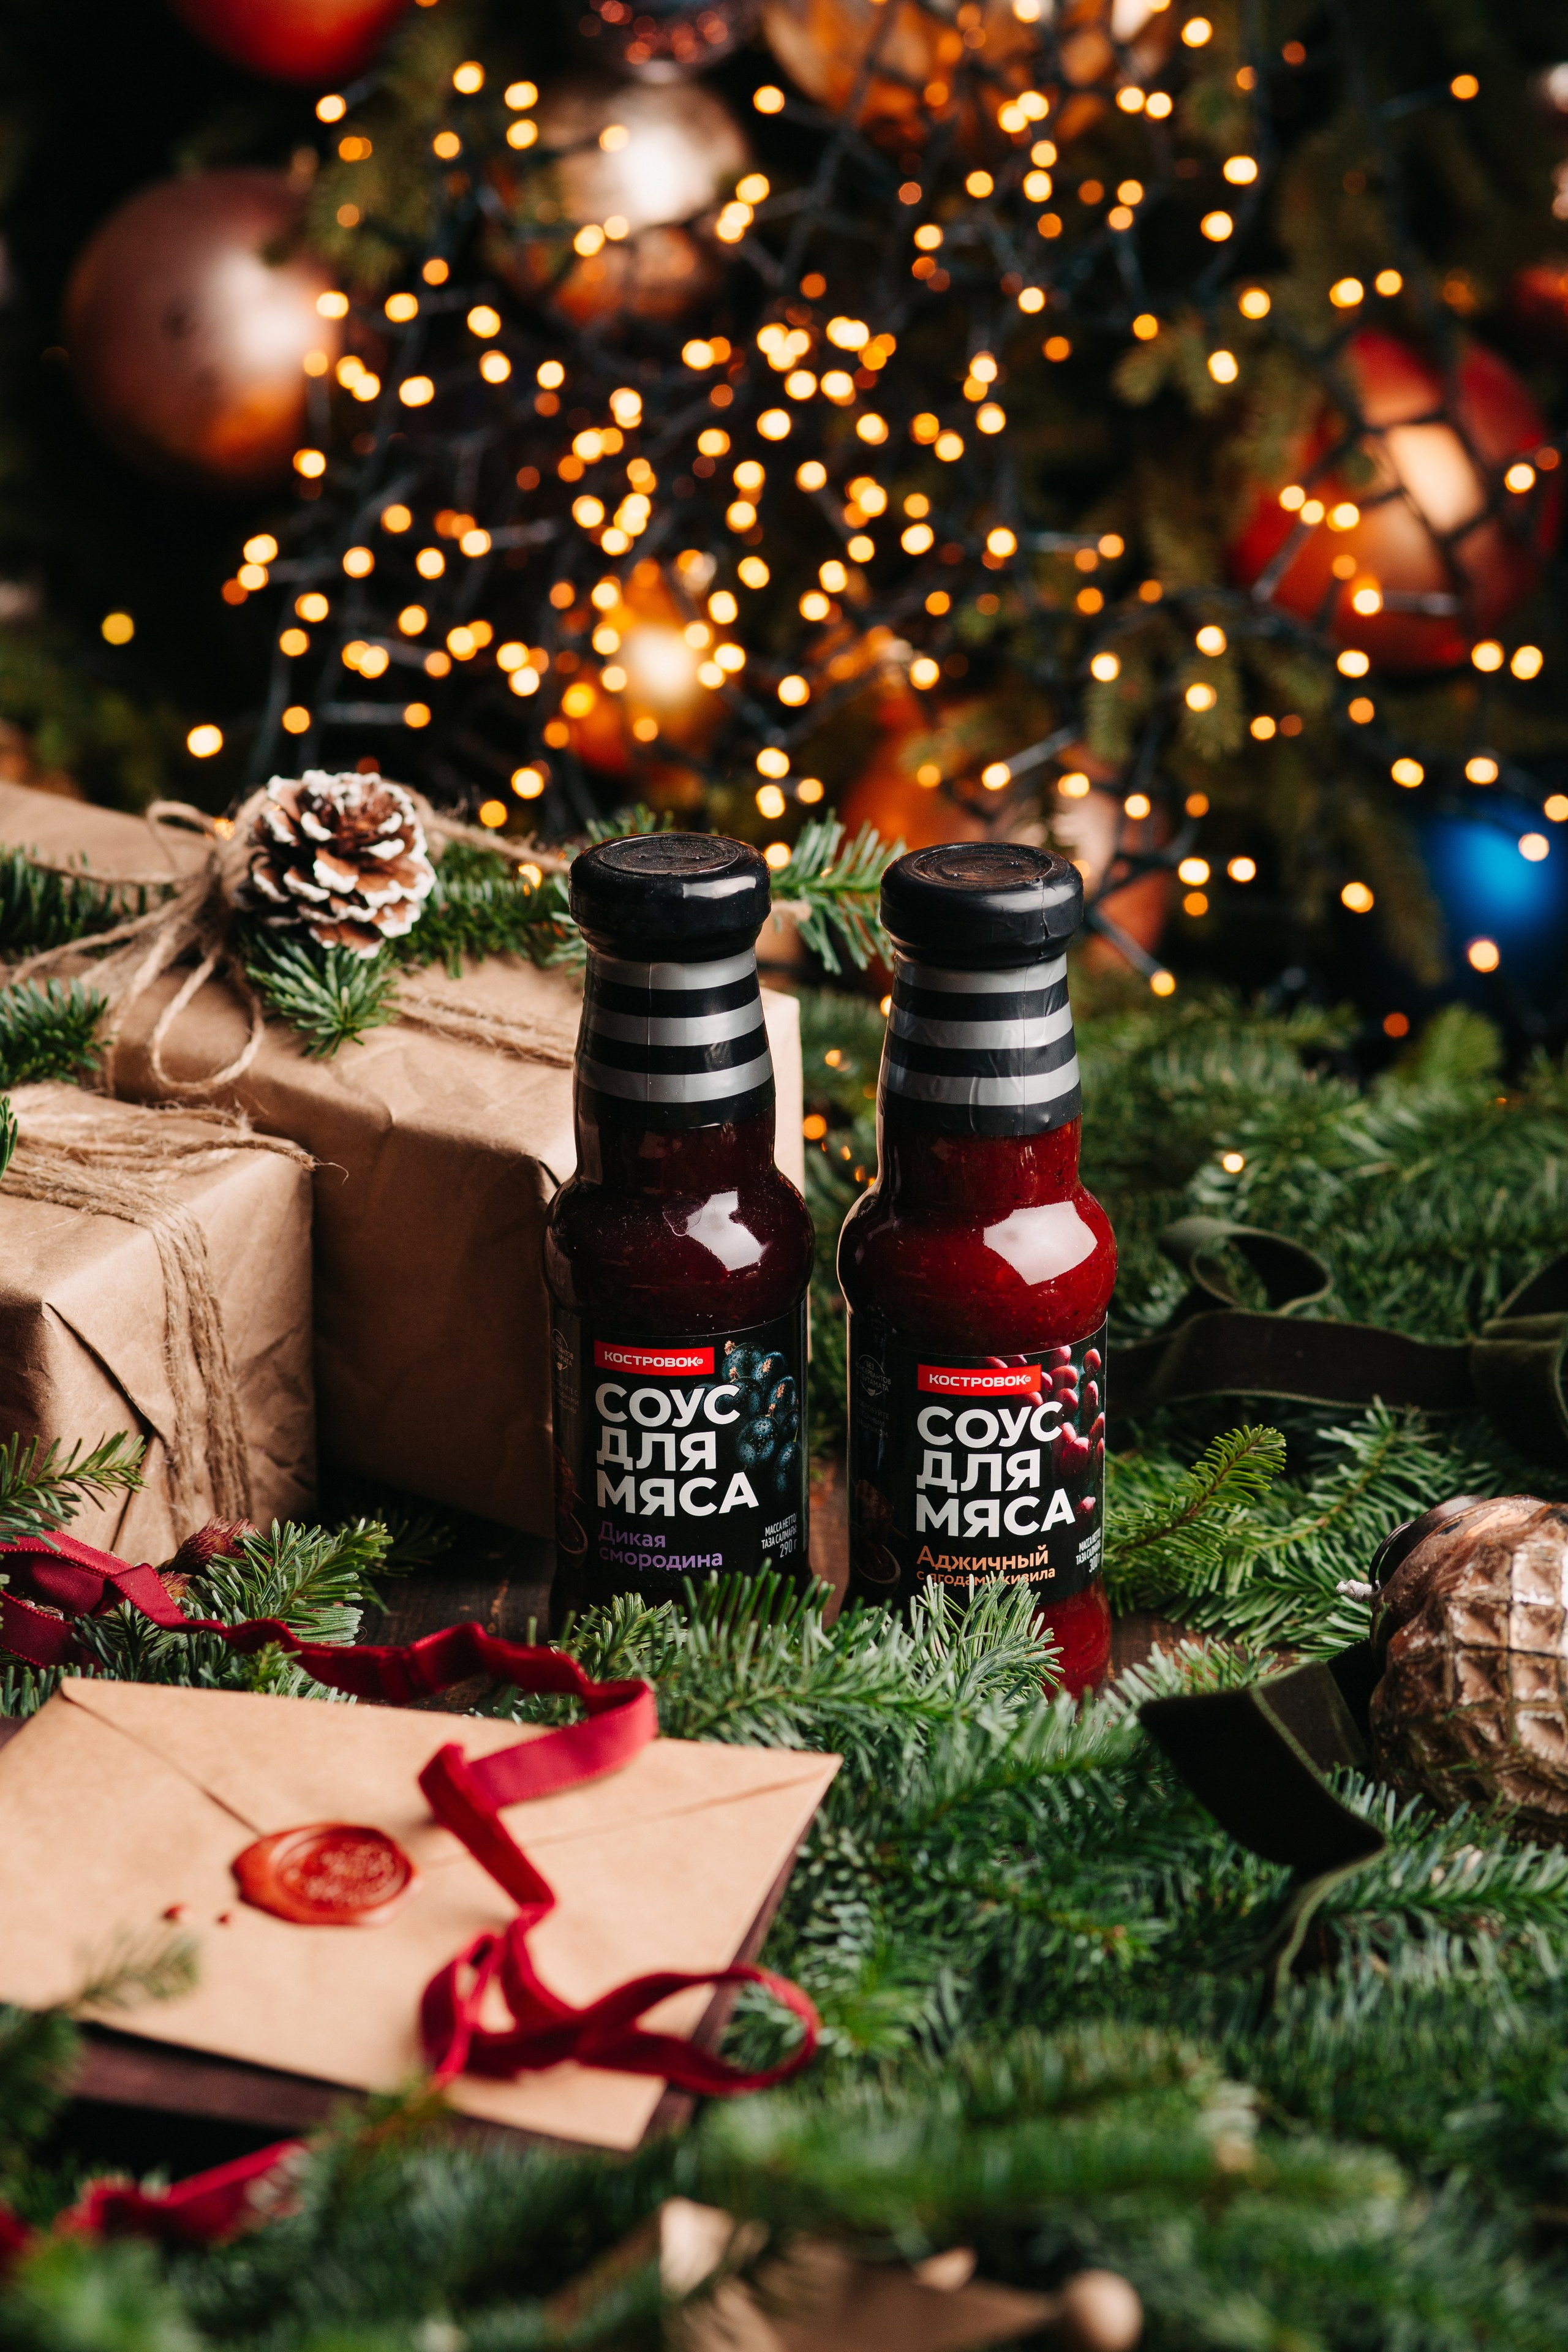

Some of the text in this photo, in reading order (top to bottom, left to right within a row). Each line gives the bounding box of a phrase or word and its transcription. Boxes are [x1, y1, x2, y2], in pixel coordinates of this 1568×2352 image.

[595, 1382, 741, 1428] СОУС
[917, 1401, 1063, 1449] СОУС
[597, 1425, 716, 1471] ДЛЯ
[916, 1449, 1041, 1494] ДЛЯ
[597, 1469, 760, 1517] МЯСА
[764, 1520, 782, 1537] МАССА
[916, 1488, 1076, 1538] МЯСА
[598, 1520, 666, 1548] Дикая
[761, 1536, 775, 1550] ТАЗА
[780, 1539, 793, 1558] 290
[598, 1546, 723, 1571] смородина
[916, 1544, 1049, 1572] Аджичный
